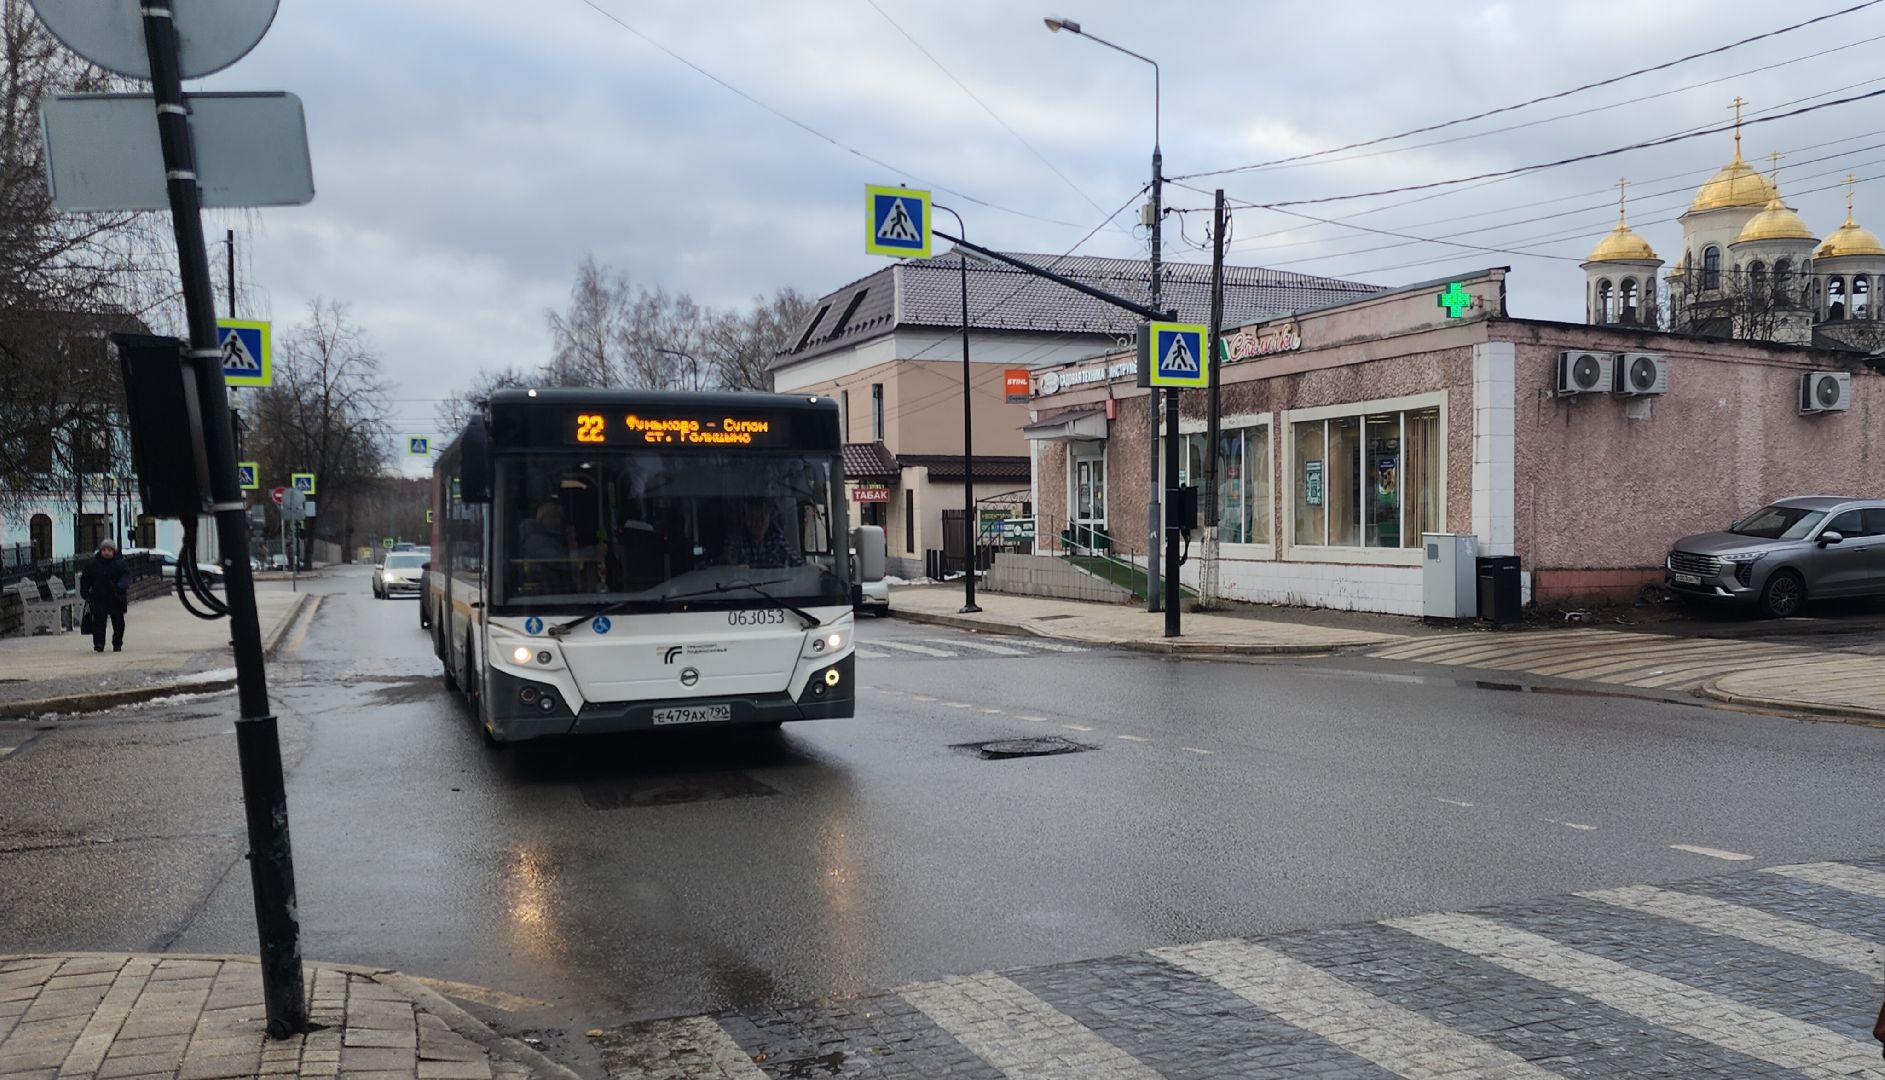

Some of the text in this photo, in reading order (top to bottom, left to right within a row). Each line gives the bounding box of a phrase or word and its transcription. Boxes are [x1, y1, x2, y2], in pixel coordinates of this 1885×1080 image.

[577, 415, 605, 442] 22
[626, 415, 699, 432] Фуньково
[644, 431, 672, 442] ст.
[854, 491, 888, 500] ТАБАК
[728, 609, 785, 626] 063053
[709, 706, 728, 717] 790
